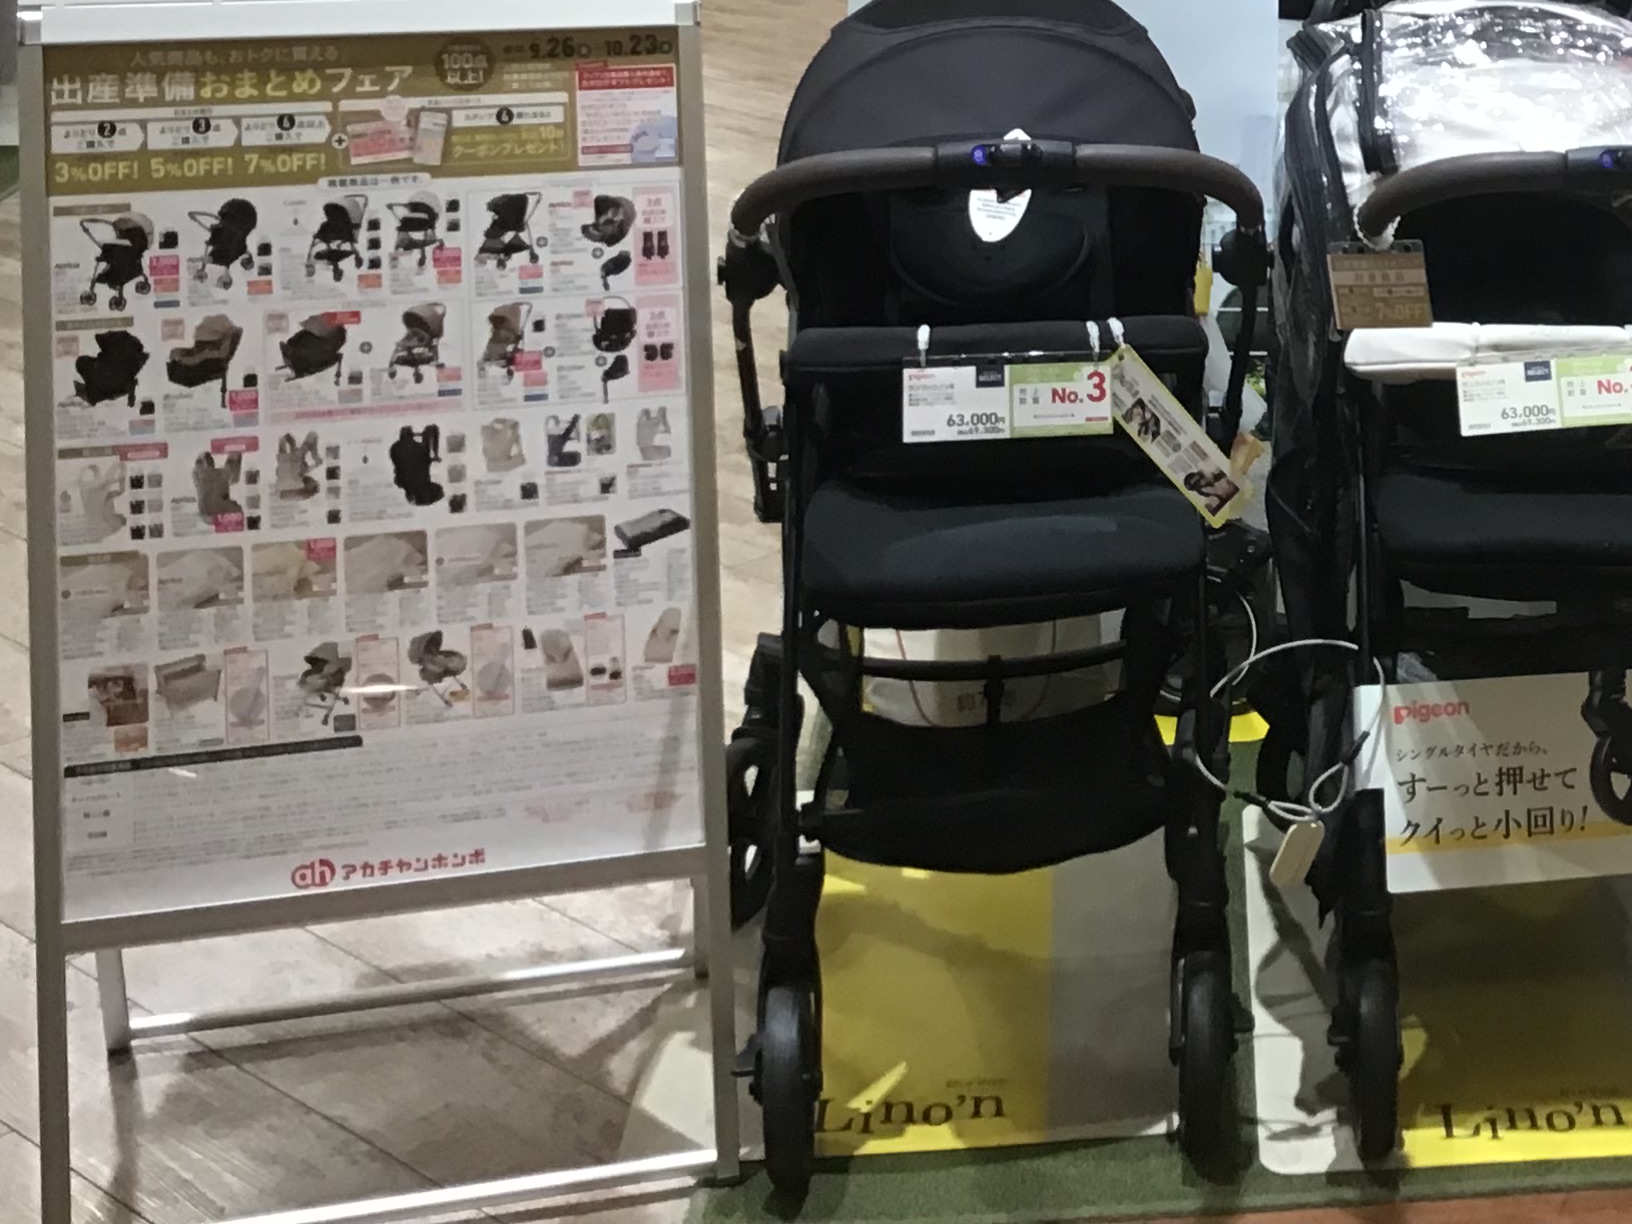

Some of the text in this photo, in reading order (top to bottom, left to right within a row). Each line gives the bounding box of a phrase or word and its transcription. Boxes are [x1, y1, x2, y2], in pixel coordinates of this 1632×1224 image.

[51, 65, 414, 106] 出産準備おまとめフェア
[54, 160, 139, 184] 3%OFF!
[150, 155, 235, 180] 5%OFF!
[243, 151, 327, 176] 7%OFF!
[1050, 370, 1107, 405] No.3
[1393, 698, 1470, 725] pigeon
[1396, 739, 1549, 763] シングルタイヤだから、
[1398, 764, 1580, 804] すーっと押せて
[1398, 804, 1589, 847] クイっと小回り!
[341, 847, 486, 881] アカチャンホンポ
[814, 1094, 1007, 1135] Lino'n
